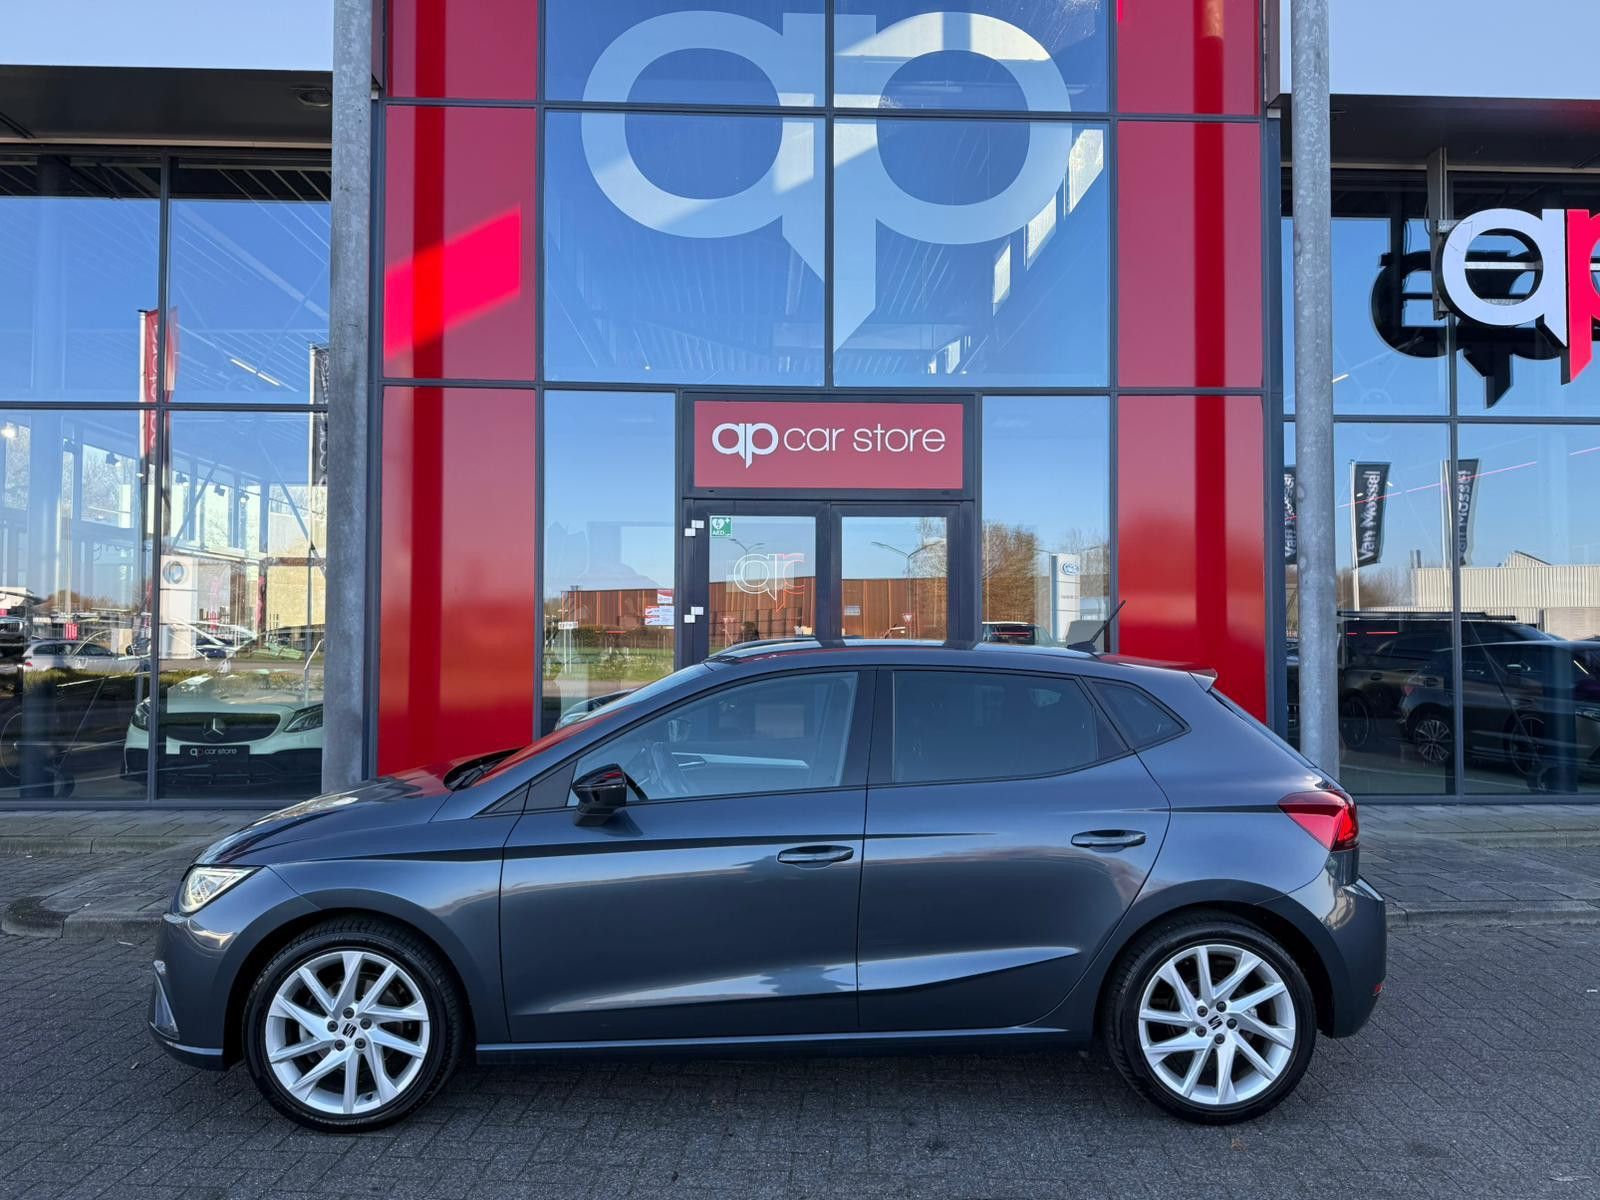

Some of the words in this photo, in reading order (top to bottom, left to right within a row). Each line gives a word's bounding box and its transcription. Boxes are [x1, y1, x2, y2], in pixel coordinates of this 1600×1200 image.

[1442, 207, 1600, 383] a
[712, 422, 779, 469] ap
[783, 428, 845, 452] car
[852, 423, 946, 452] store
[1360, 470, 1380, 528] Mossel
[1358, 531, 1376, 560] Van
